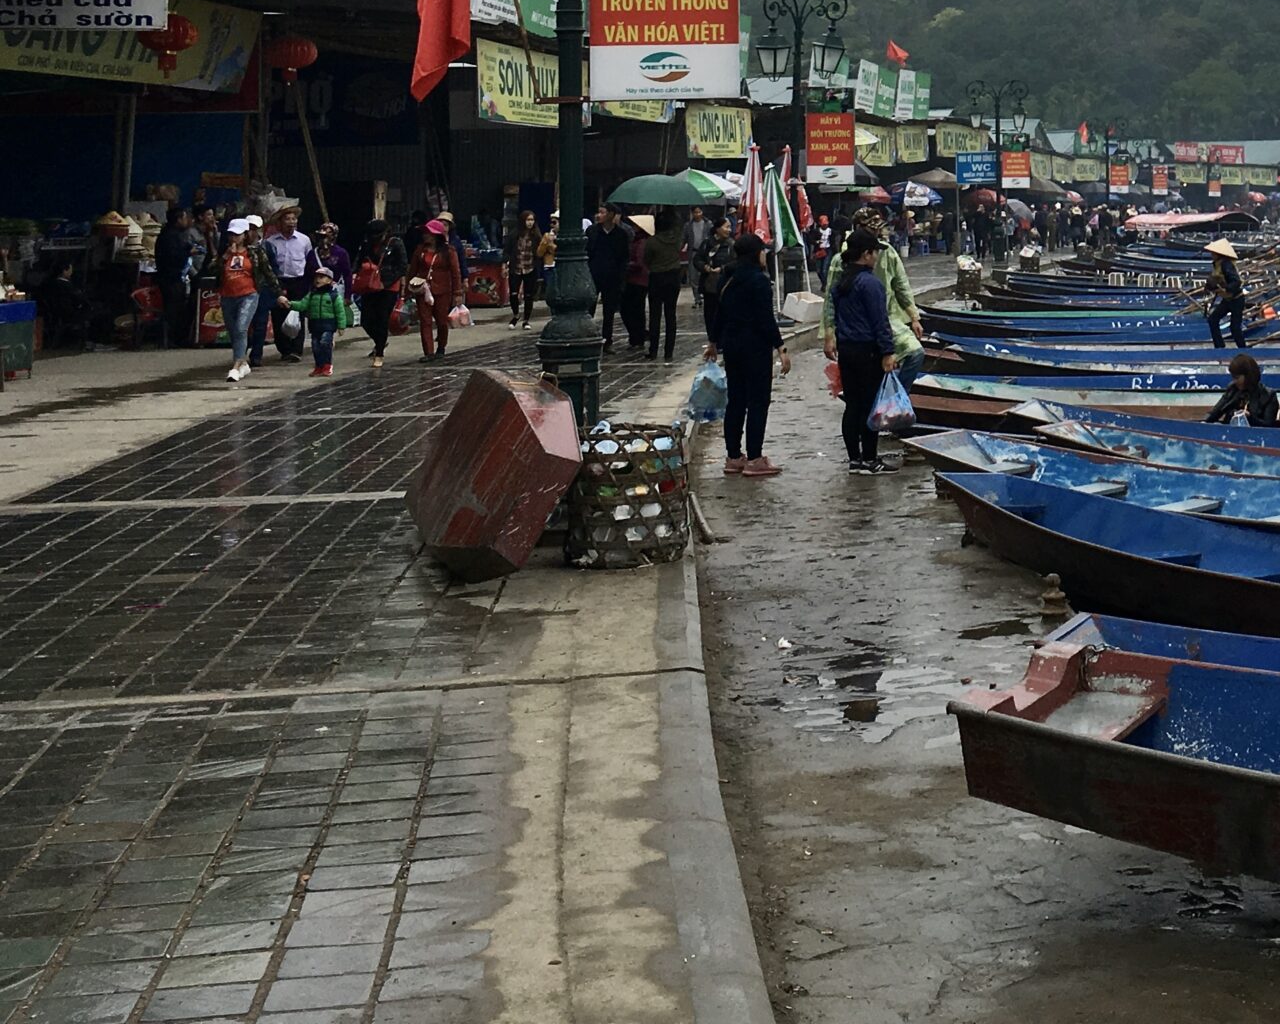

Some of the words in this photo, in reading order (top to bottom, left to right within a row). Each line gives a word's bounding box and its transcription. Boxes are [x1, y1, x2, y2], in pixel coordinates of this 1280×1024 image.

[0, 9, 57, 26] Chả
[76, 11, 153, 26] sườn
[604, 22, 638, 43] VĂN
[644, 23, 678, 42] HÓA
[682, 20, 725, 44] VIỆT!
[499, 56, 523, 97] SƠN
[698, 112, 720, 143] LONG
[722, 113, 737, 143] MAI
[972, 163, 991, 171] WC
